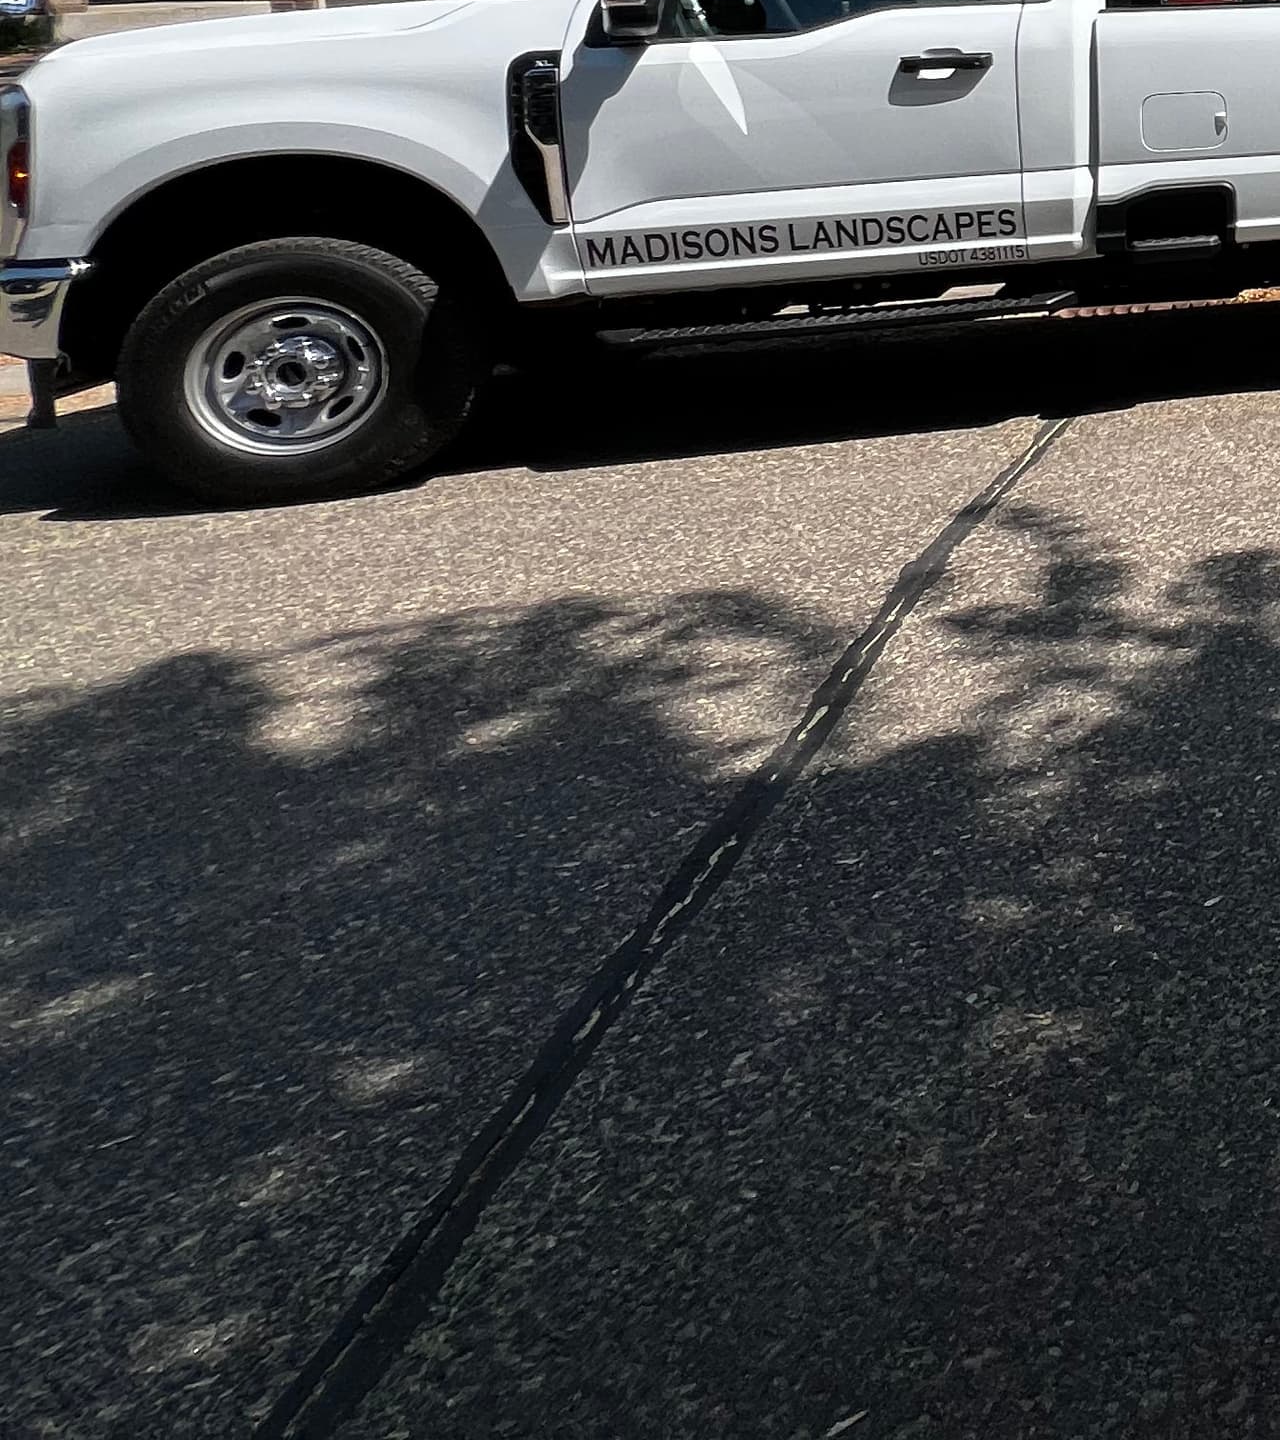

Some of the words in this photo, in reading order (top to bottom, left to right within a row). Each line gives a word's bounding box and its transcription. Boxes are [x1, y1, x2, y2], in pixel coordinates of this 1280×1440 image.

[586, 224, 780, 267] MADISONS
[788, 209, 1017, 251] LANDSCAPES
[918, 249, 967, 265] USDOT
